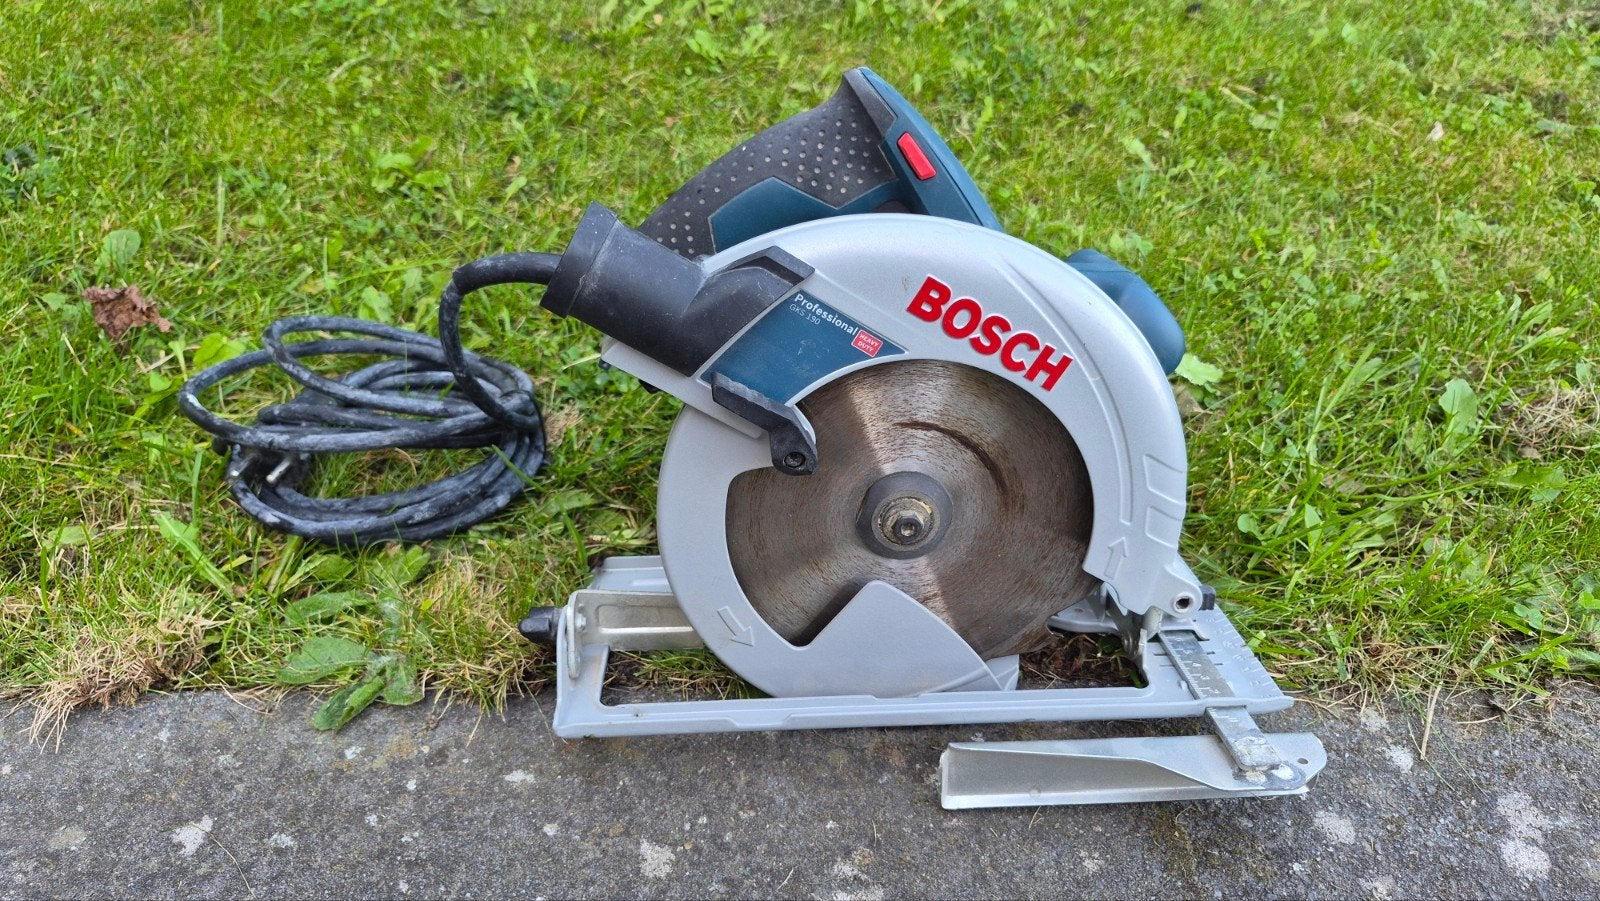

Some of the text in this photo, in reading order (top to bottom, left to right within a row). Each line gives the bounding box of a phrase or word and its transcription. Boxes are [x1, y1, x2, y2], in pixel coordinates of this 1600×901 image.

[789, 303, 821, 325] GKS 190
[794, 293, 858, 336] Professional
[858, 334, 879, 347] HEAVY
[906, 275, 1073, 391] BOSCH
[857, 341, 874, 352] DUTY
